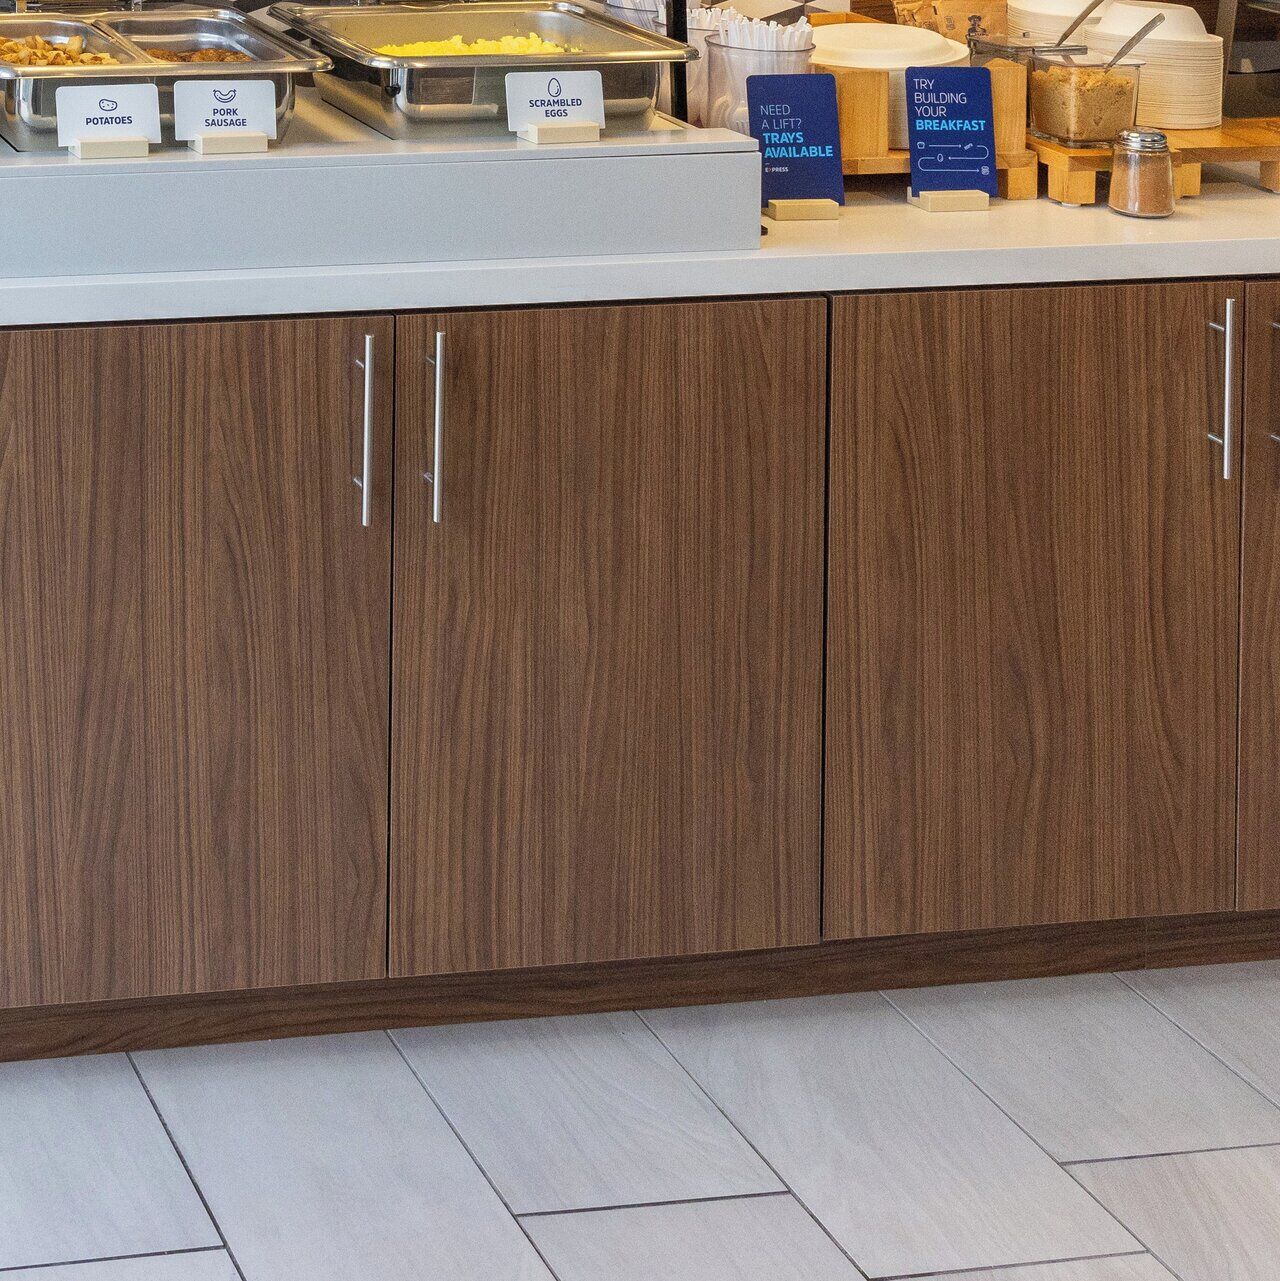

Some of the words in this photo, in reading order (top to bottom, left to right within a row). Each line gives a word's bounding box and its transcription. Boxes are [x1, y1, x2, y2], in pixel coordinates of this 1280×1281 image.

[913, 78, 935, 90] TRY
[528, 98, 583, 108] SCRAMBLED
[914, 92, 967, 104] BUILDING
[212, 108, 239, 117] PORK
[544, 109, 568, 118] EGGS
[760, 104, 791, 116] NEED
[914, 105, 947, 117] YOUR
[85, 115, 133, 126] POTATOES
[204, 118, 247, 127] SAUSAGE
[761, 119, 770, 130] A
[773, 118, 802, 130] LIFT?
[915, 119, 986, 131] BREAKFAST
[762, 131, 804, 144] TRAYS
[764, 145, 834, 159] AVAILABLE
